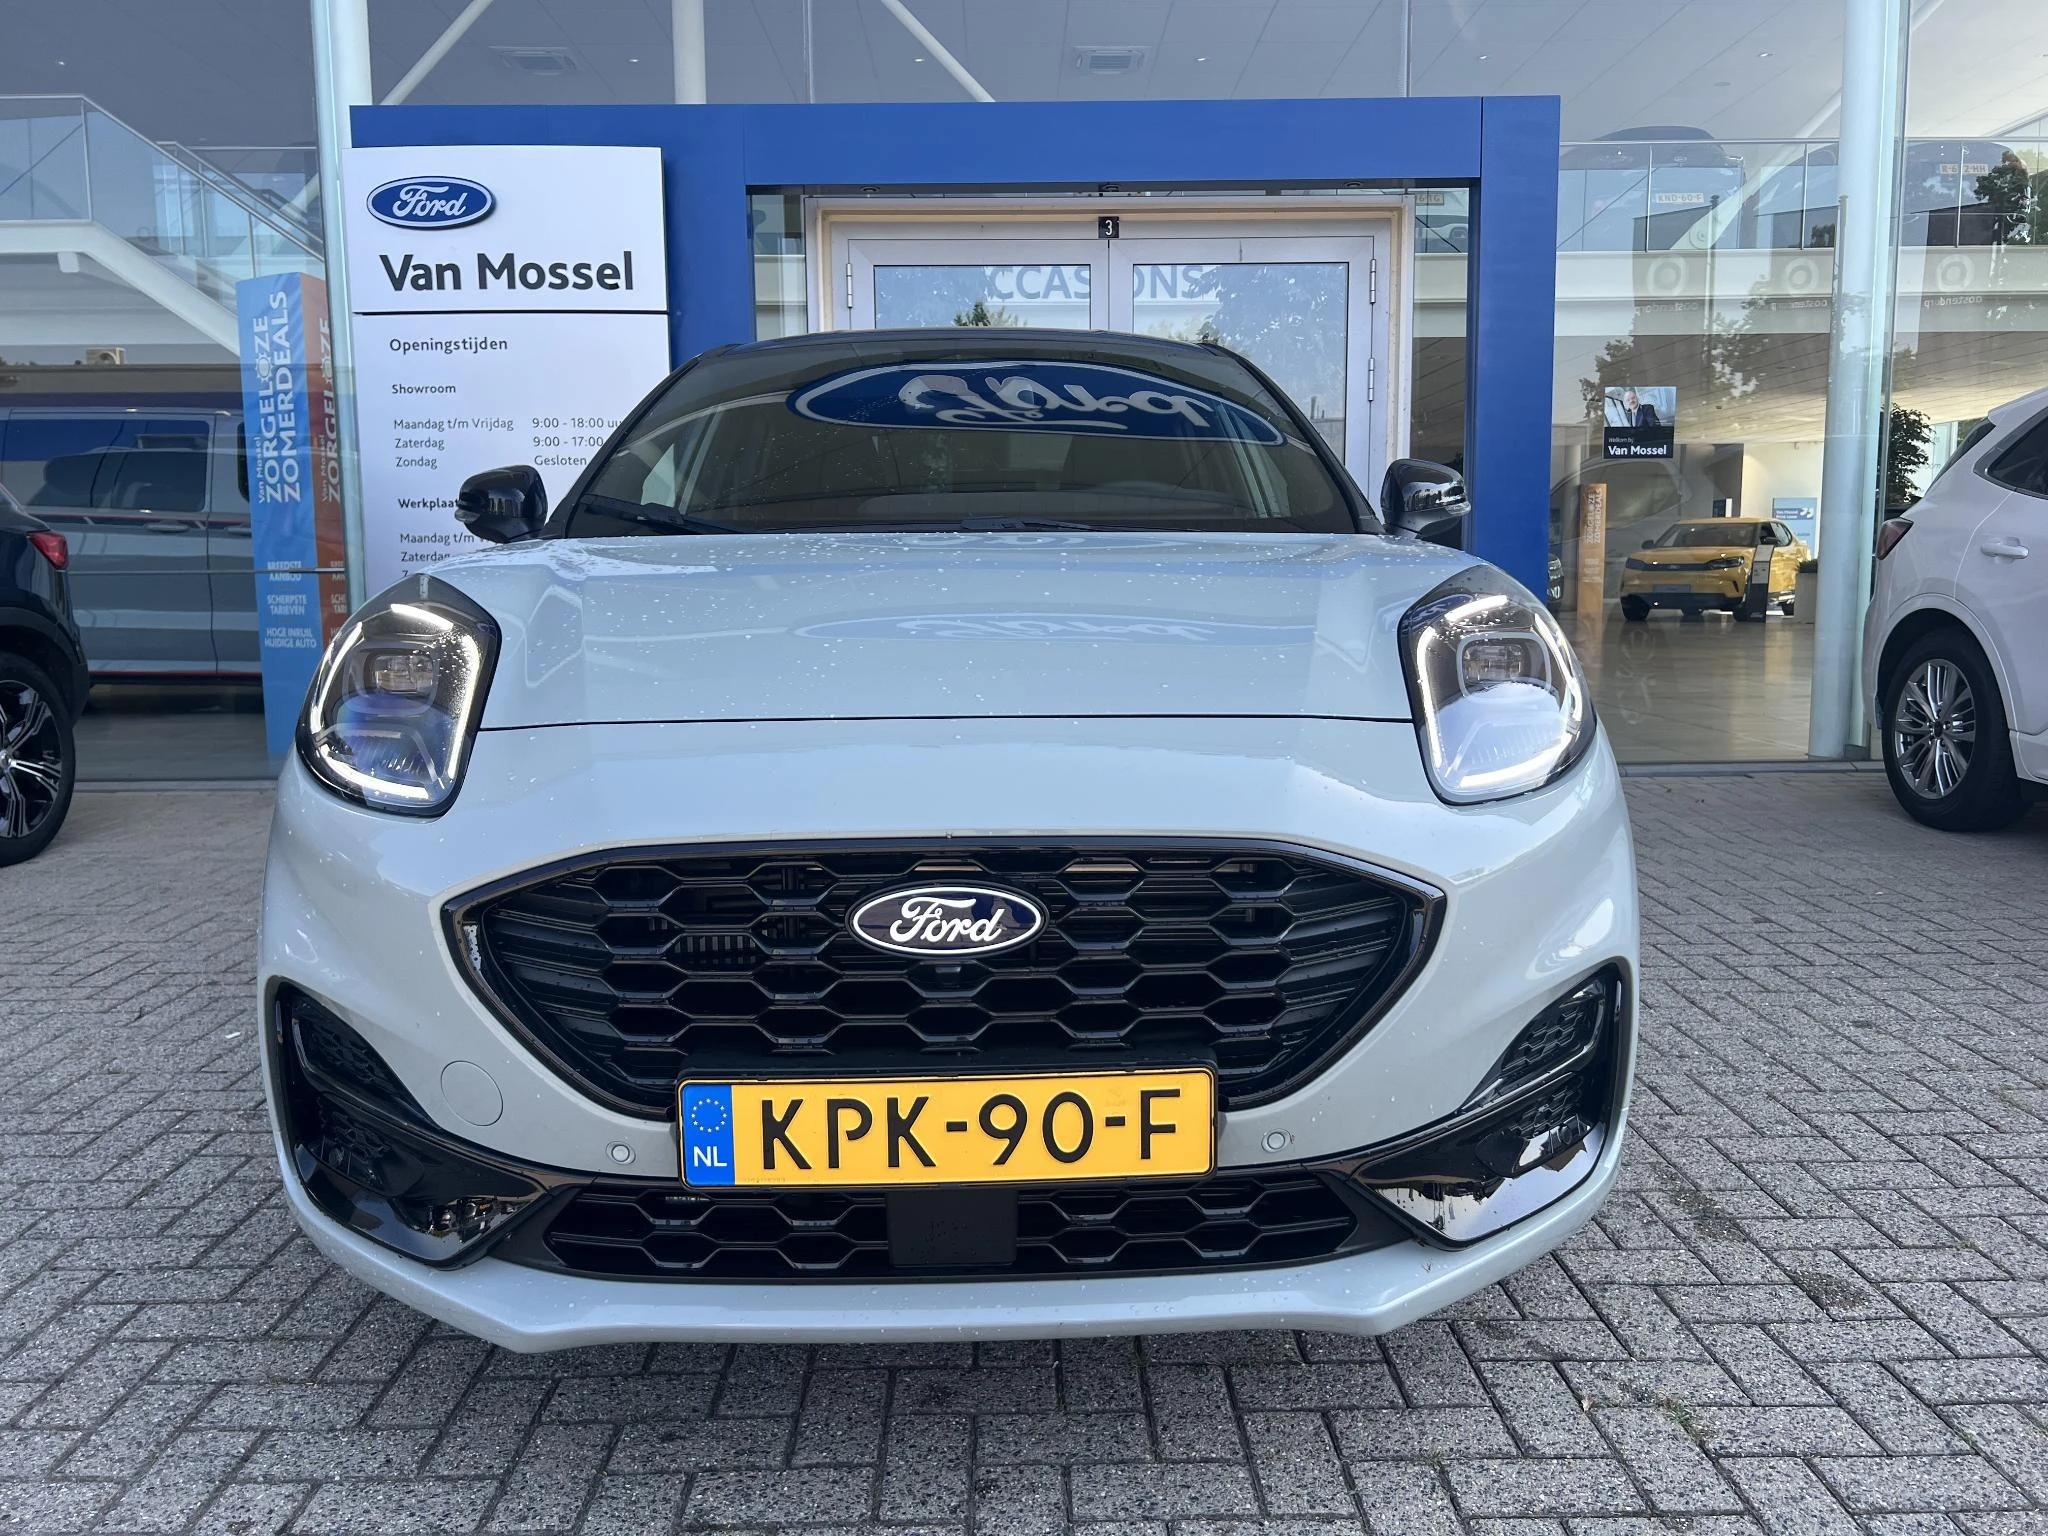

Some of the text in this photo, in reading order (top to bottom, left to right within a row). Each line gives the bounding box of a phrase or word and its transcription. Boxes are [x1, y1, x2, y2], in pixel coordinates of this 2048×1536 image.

[392, 184, 468, 217] Ford
[1105, 219, 1113, 236] 3
[379, 251, 634, 291] Van Mossel
[389, 337, 508, 355] Openingstijden
[391, 383, 456, 395] Showroom
[270, 290, 301, 504] ZOMERDEALS
[393, 419, 445, 432] Maandag
[447, 418, 469, 430] t/m
[472, 418, 514, 431] Vrijdag
[532, 418, 559, 429] 9:00
[570, 417, 604, 429] 18:00
[395, 438, 445, 451] Zaterdag
[533, 436, 560, 447] 9:00
[572, 436, 604, 447] 17:00
[1608, 444, 1667, 455] Van Mossel
[396, 455, 587, 470] Zondag Gesloten
[398, 498, 459, 511] Werkplaat
[400, 532, 450, 546] Maandag
[453, 532, 475, 544] t/m
[267, 594, 307, 606] SCHERPSTE
[270, 605, 305, 616] TARIEVEN
[266, 627, 287, 638] HOGE
[295, 638, 317, 649] AUTO
[890, 895, 1004, 942] Ford
[761, 1088, 1180, 1170] KPK-90-F
[693, 1145, 728, 1168] NL
